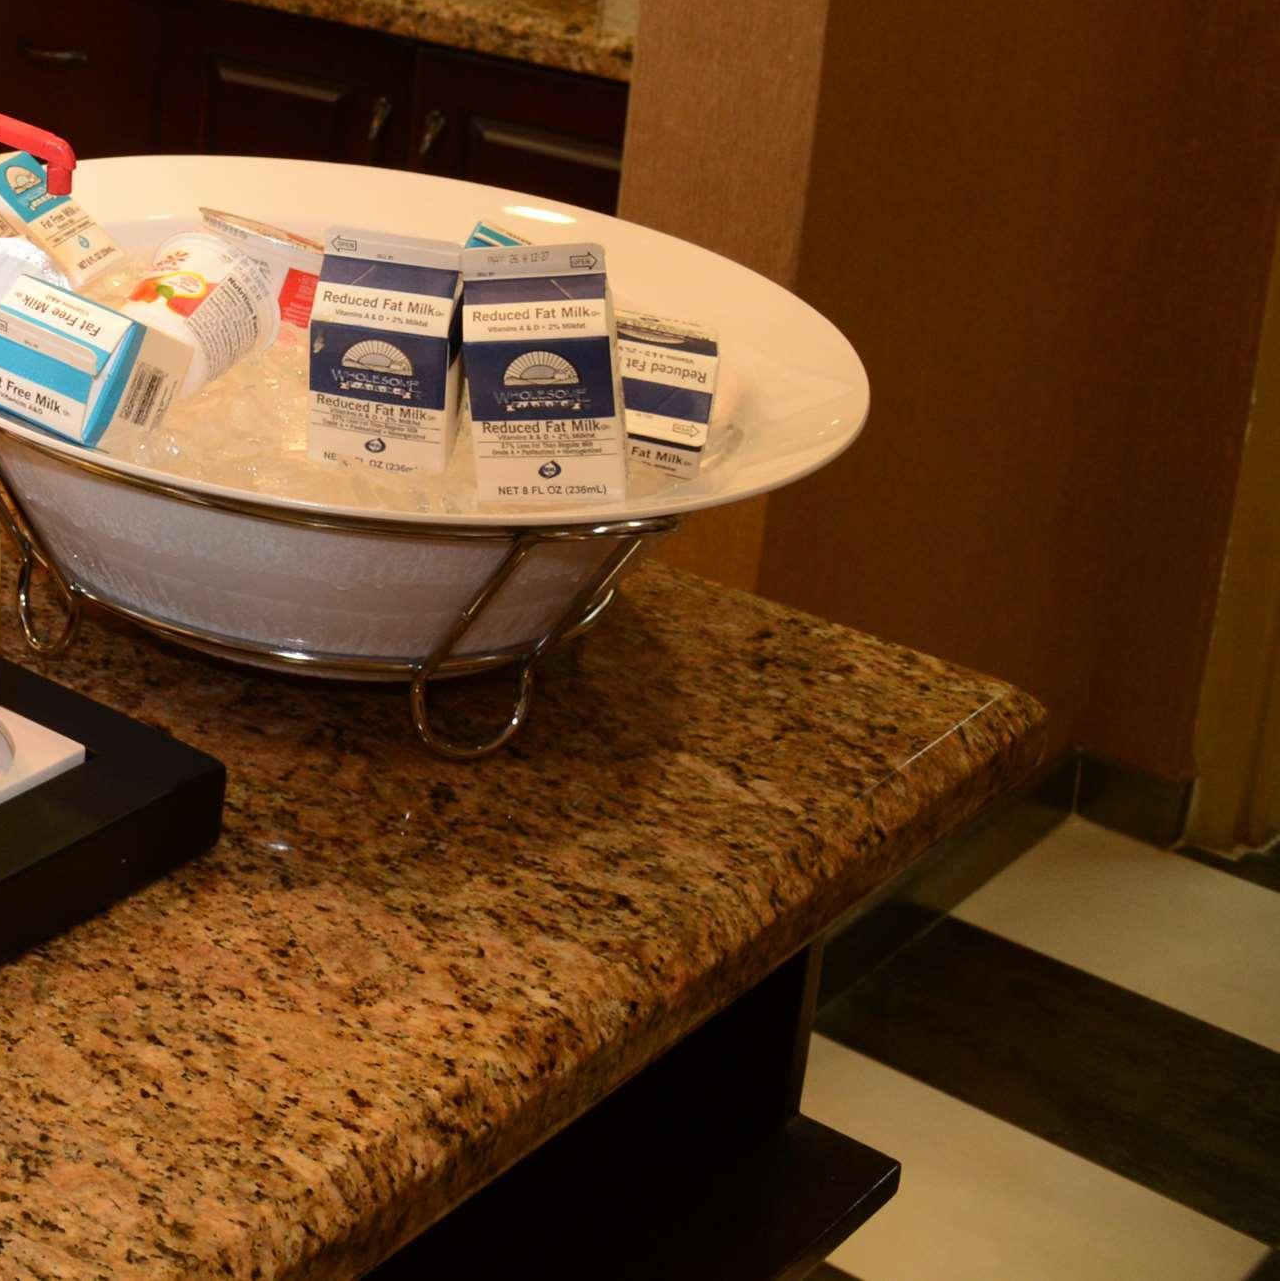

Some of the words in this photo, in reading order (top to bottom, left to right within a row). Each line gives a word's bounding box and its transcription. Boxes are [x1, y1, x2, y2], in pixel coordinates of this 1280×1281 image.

[22, 294, 51, 312] Milk
[322, 290, 379, 308] Reduced
[382, 298, 402, 312] Fat
[407, 302, 436, 317] Milk
[51, 308, 80, 327] Free
[335, 308, 363, 319] Vitamins
[472, 309, 530, 323] Reduced
[535, 308, 556, 320] Fat
[561, 306, 590, 318] Milk
[80, 319, 101, 337] Fat
[487, 324, 517, 333] Vitamins
[626, 357, 647, 373] Fat
[651, 363, 707, 384] Reduced
[6, 379, 31, 400] Free
[35, 392, 61, 414] Milk
[316, 393, 370, 413] Reduced
[375, 404, 394, 416] Fat
[400, 407, 427, 421] Milk
[482, 421, 540, 433] Reduced
[545, 420, 566, 433] Fat
[572, 419, 600, 432] Milk
[631, 446, 651, 459] Fat
[655, 451, 683, 465] Milk
[498, 486, 519, 495] NET
[522, 486, 528, 494] 8
[531, 486, 544, 494] FL
[547, 485, 562, 494] OZ
[565, 484, 607, 495] (236mL)
